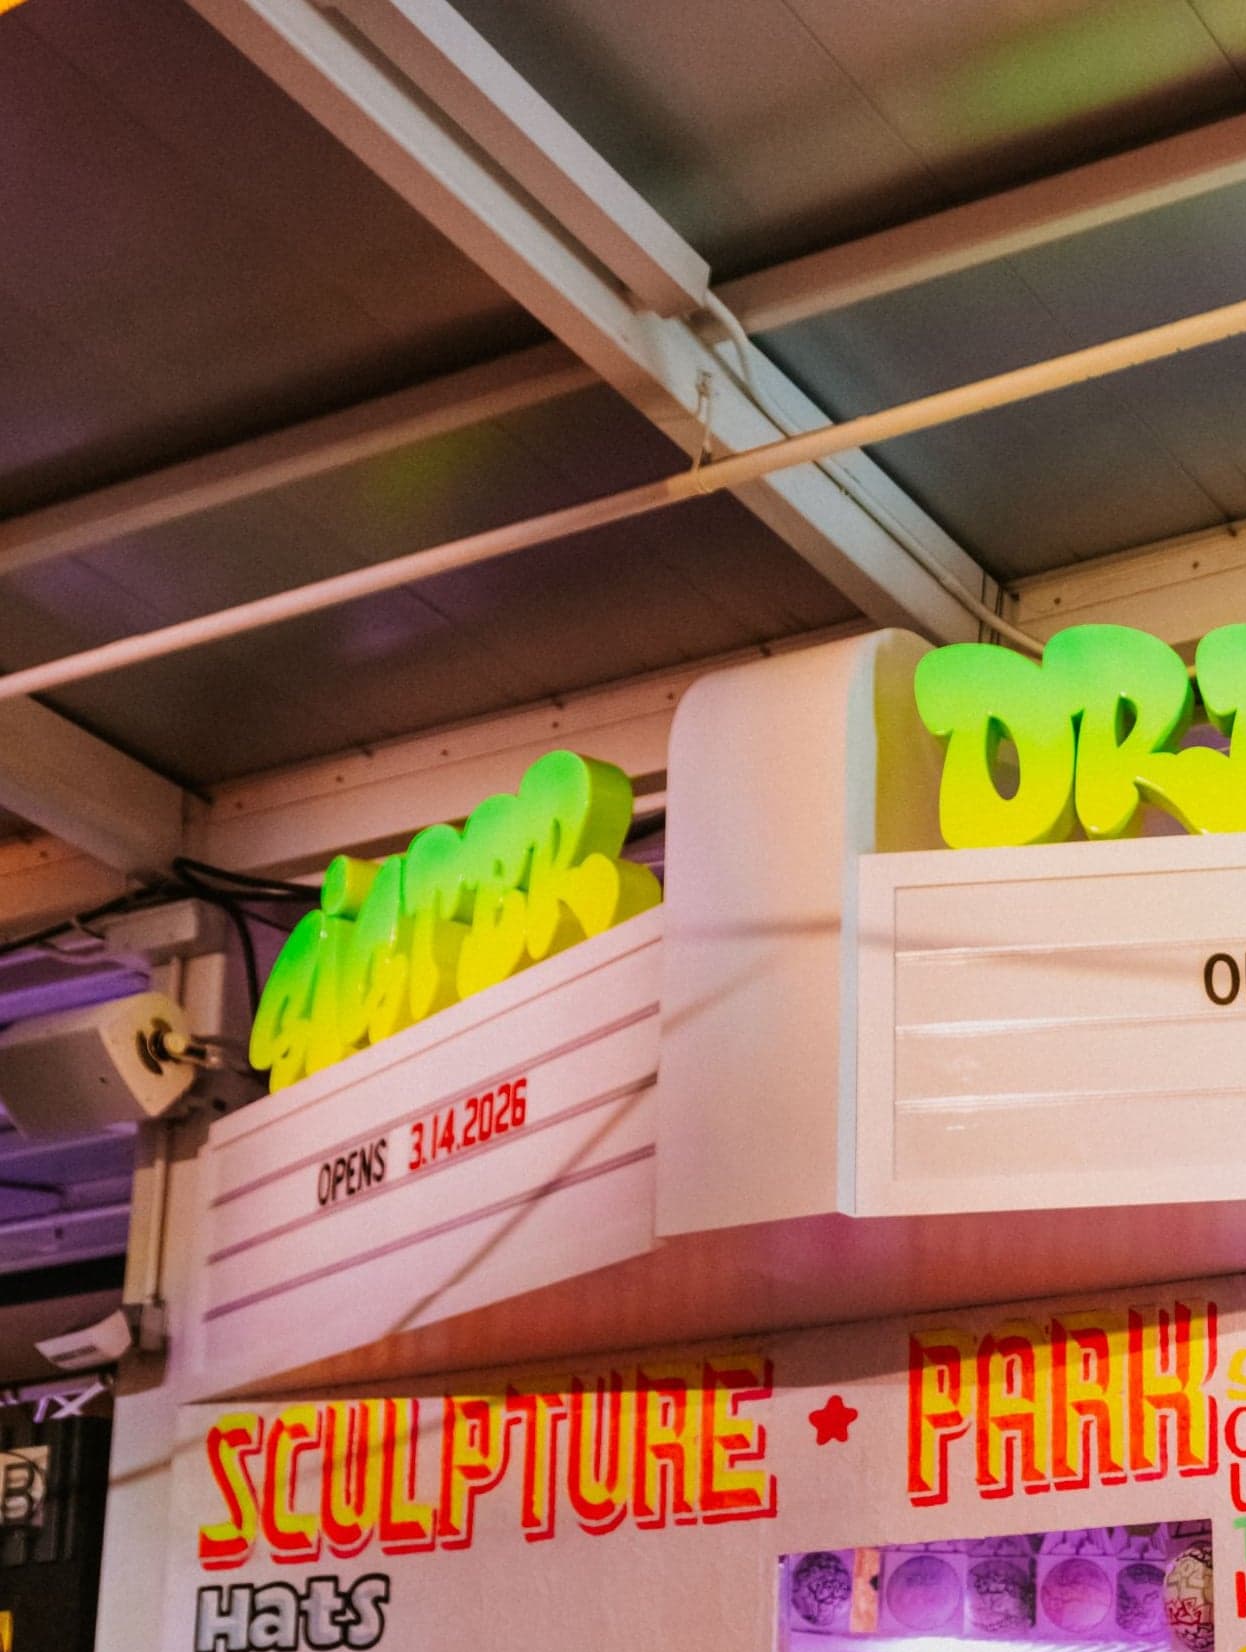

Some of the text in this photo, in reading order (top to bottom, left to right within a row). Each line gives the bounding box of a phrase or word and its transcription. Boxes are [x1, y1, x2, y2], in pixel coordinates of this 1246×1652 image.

[317, 1076, 528, 1206] OPENS 3.14.2026
[198, 1299, 1219, 1571] SCULPTURE PARK
